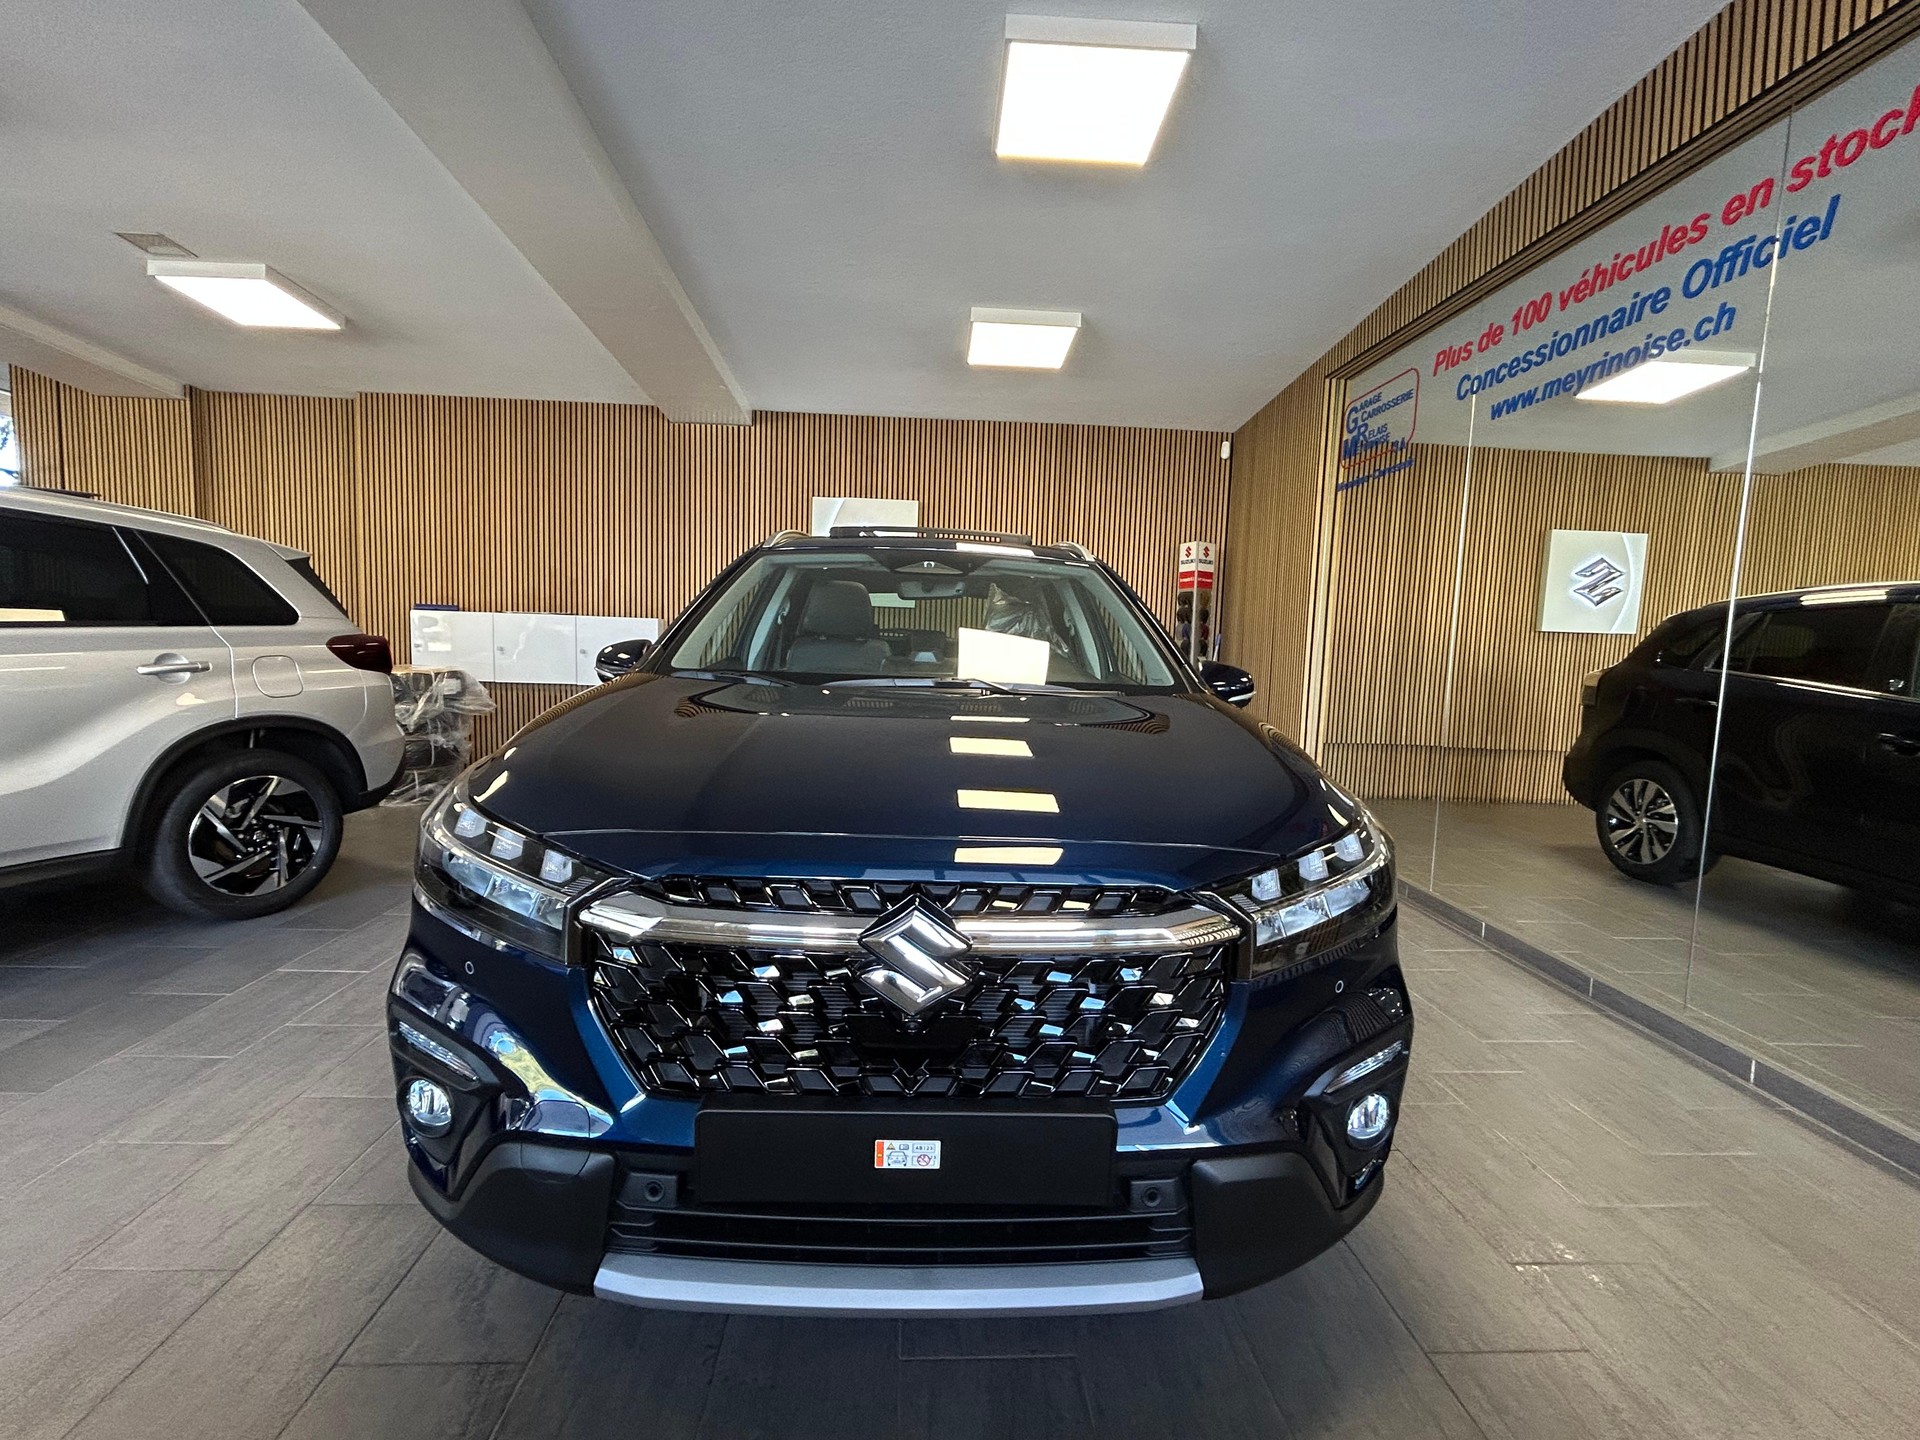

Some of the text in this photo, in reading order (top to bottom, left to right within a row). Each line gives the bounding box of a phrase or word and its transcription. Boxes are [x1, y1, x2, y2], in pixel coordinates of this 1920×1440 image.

[1433, 341, 1473, 377] Plus
[1477, 323, 1504, 353] de
[1512, 293, 1553, 336] 100
[1559, 213, 1711, 312] véhicules
[1721, 178, 1775, 226] en
[1457, 193, 1841, 400] Concessionnaire Officiel
[1361, 388, 1414, 422] CARROSSERIE
[1490, 301, 1736, 420] www.meyrinoise.ch
